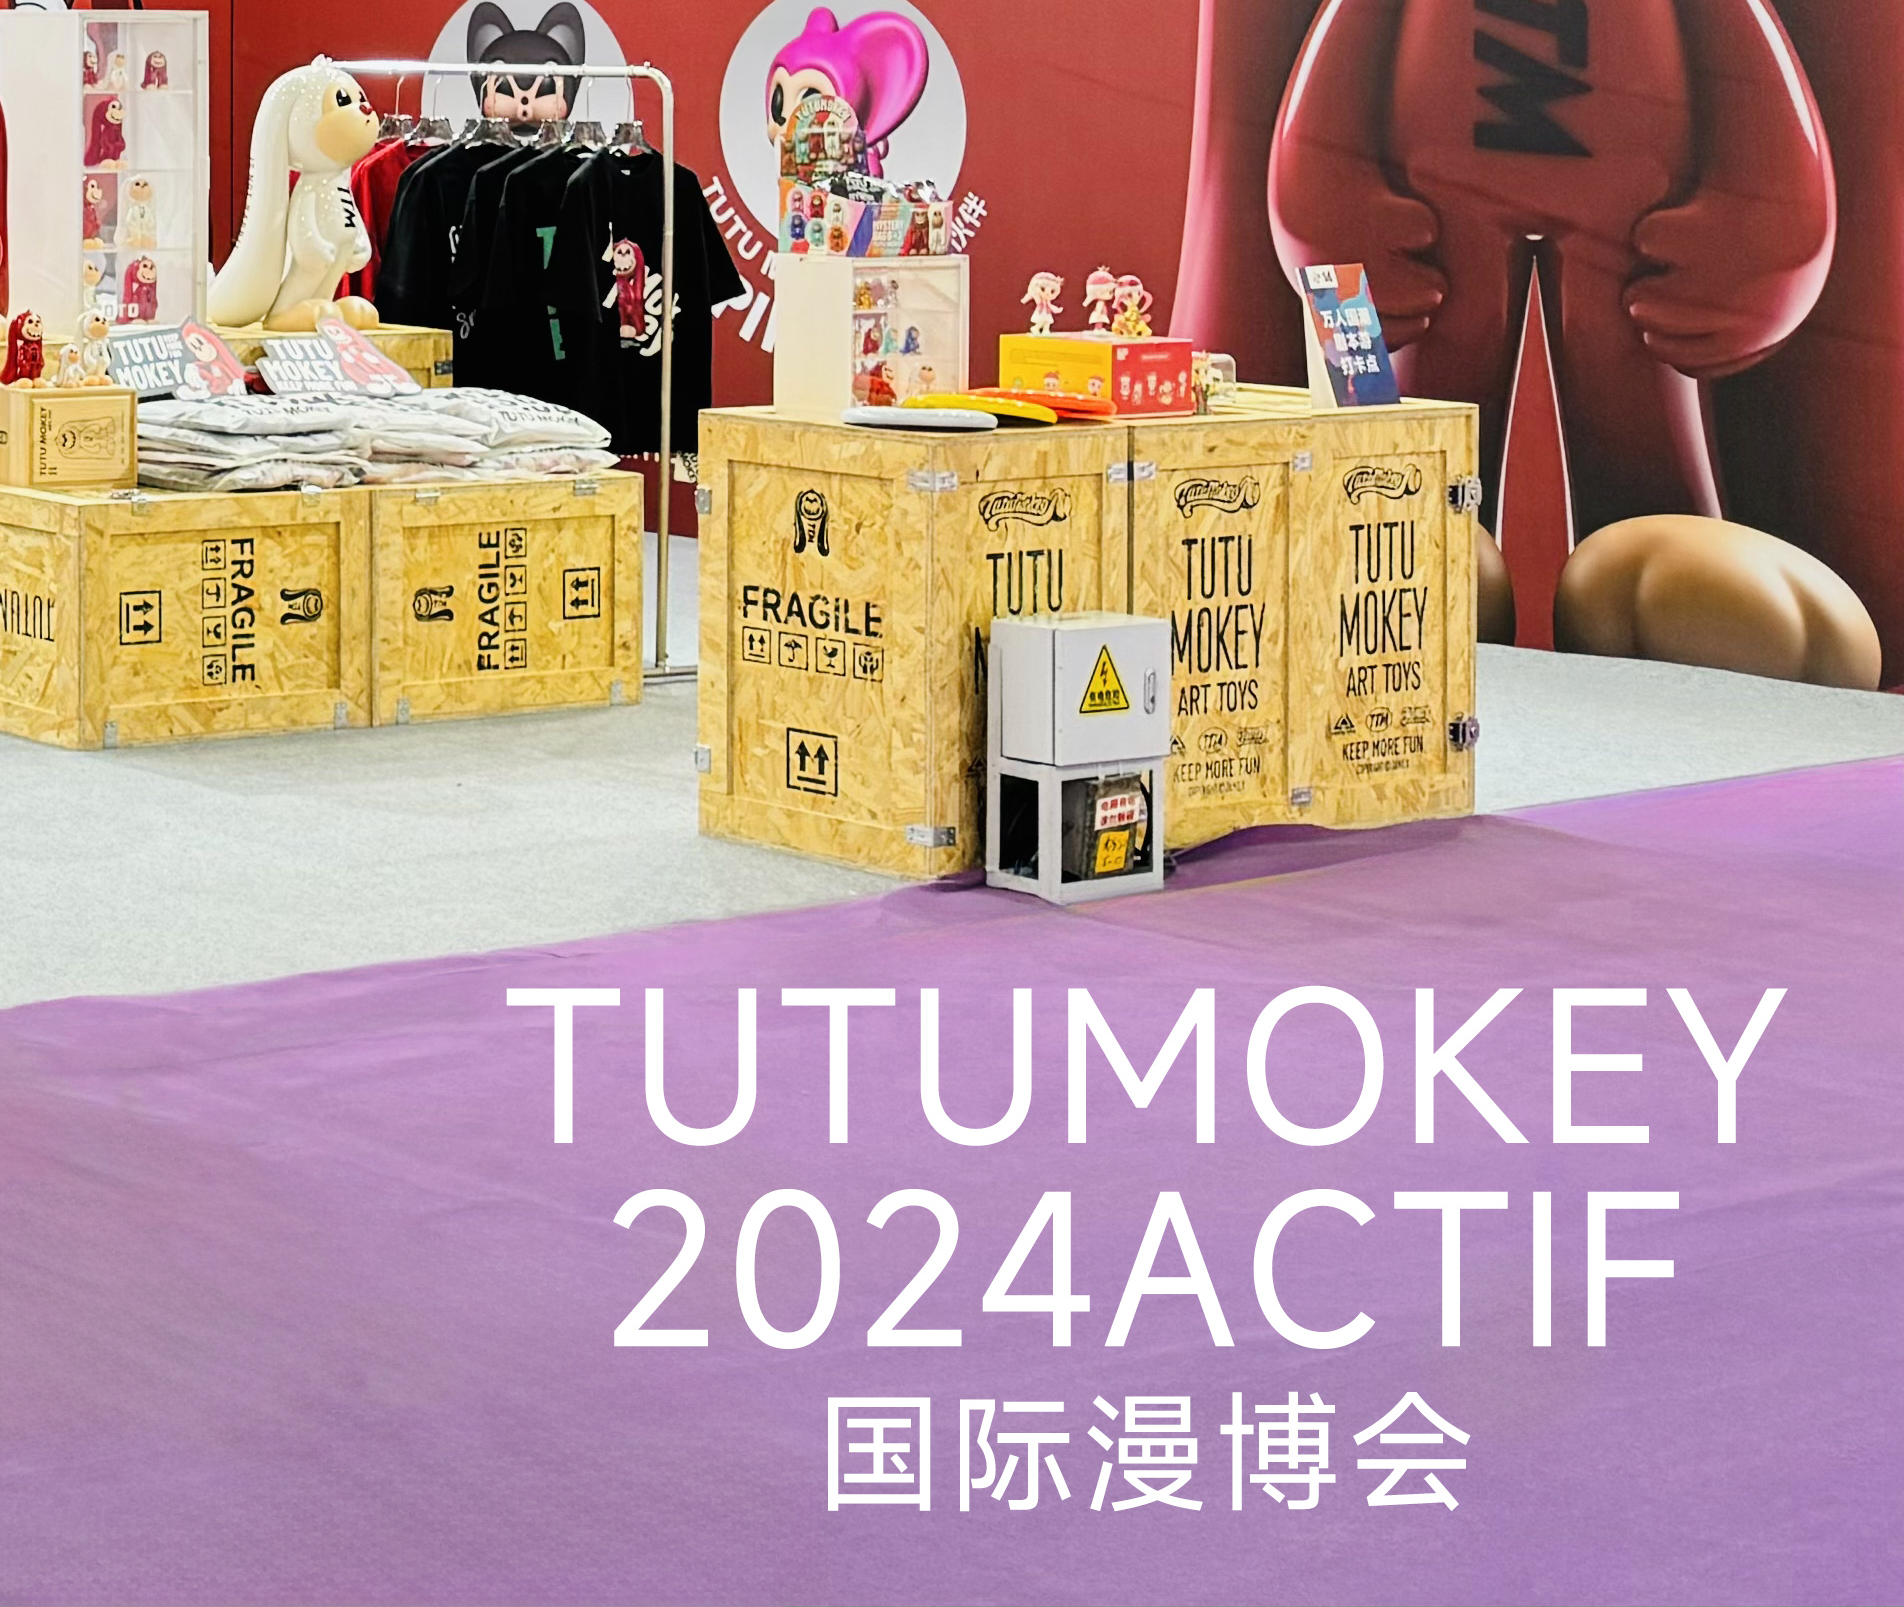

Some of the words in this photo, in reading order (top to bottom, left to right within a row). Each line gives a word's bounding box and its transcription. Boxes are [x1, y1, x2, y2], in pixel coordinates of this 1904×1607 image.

[337, 186, 357, 229] TTM
[703, 175, 764, 261] TUTU
[112, 334, 168, 367] TUTU
[262, 360, 344, 383] MOKEY
[265, 338, 336, 361] TUTU
[115, 360, 184, 392] MOKEY
[1181, 533, 1253, 601] TUTU
[1349, 519, 1415, 585] TUTU
[476, 529, 501, 672] FRAGILE
[985, 548, 1064, 618] TUTU
[230, 537, 256, 684] FRAGILE
[741, 585, 884, 640] FRAGILE
[1339, 586, 1429, 659] MOKEY
[1170, 602, 1265, 676] MOKEY
[1177, 684, 1209, 717] ART
[1217, 678, 1259, 714] TOYS
[1346, 666, 1377, 699] ART
[1382, 661, 1422, 694] TOYS
[1173, 761, 1202, 783] KEEP
[1206, 758, 1235, 780] MORE
[1239, 754, 1261, 775] FUN
[1342, 741, 1369, 762] KEEP
[1372, 738, 1400, 757] MORE
[1403, 735, 1424, 755] FUN
